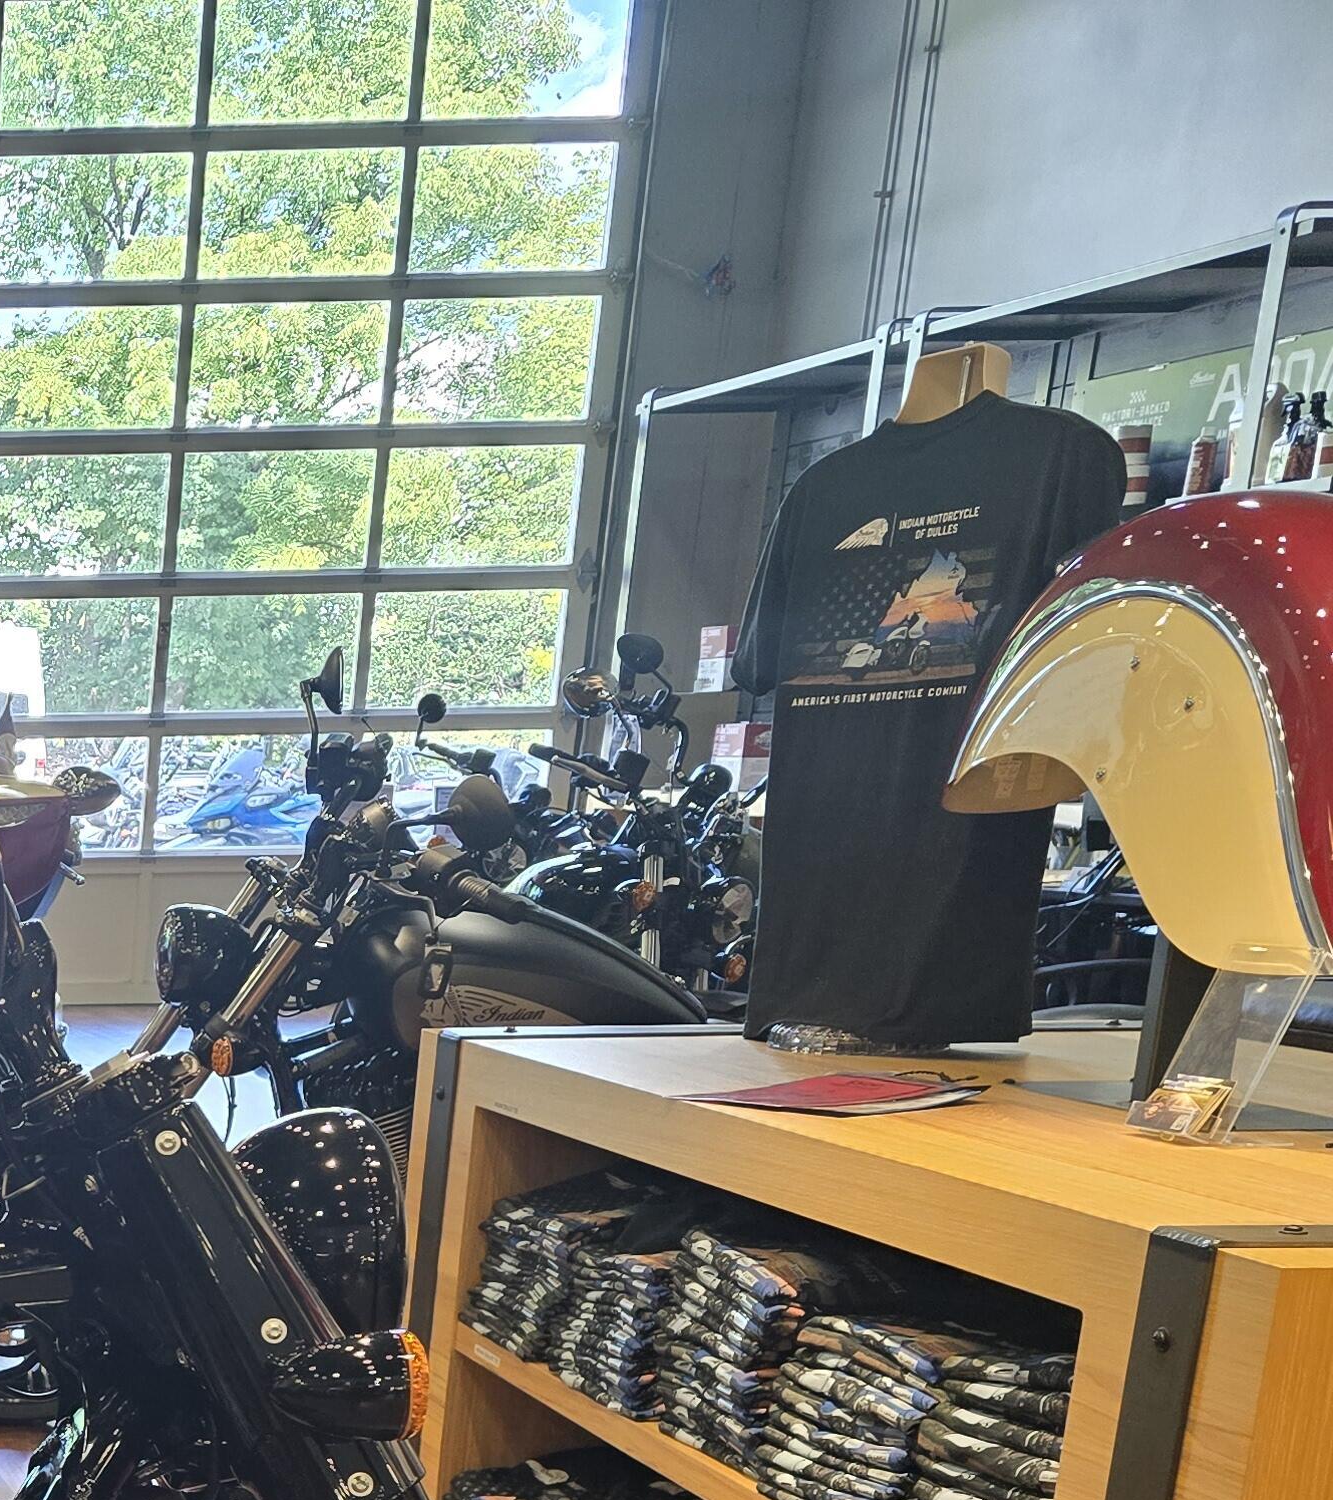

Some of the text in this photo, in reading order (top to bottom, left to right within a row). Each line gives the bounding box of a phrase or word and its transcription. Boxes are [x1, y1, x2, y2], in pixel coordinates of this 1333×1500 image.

[899, 506, 980, 530] INDIAN MOTORCYCLE
[915, 524, 958, 540] OF DULLES
[791, 685, 967, 707] AMERICA'S FIRST MOTORCYCLE COMPANY
[473, 1005, 545, 1022] Indian
